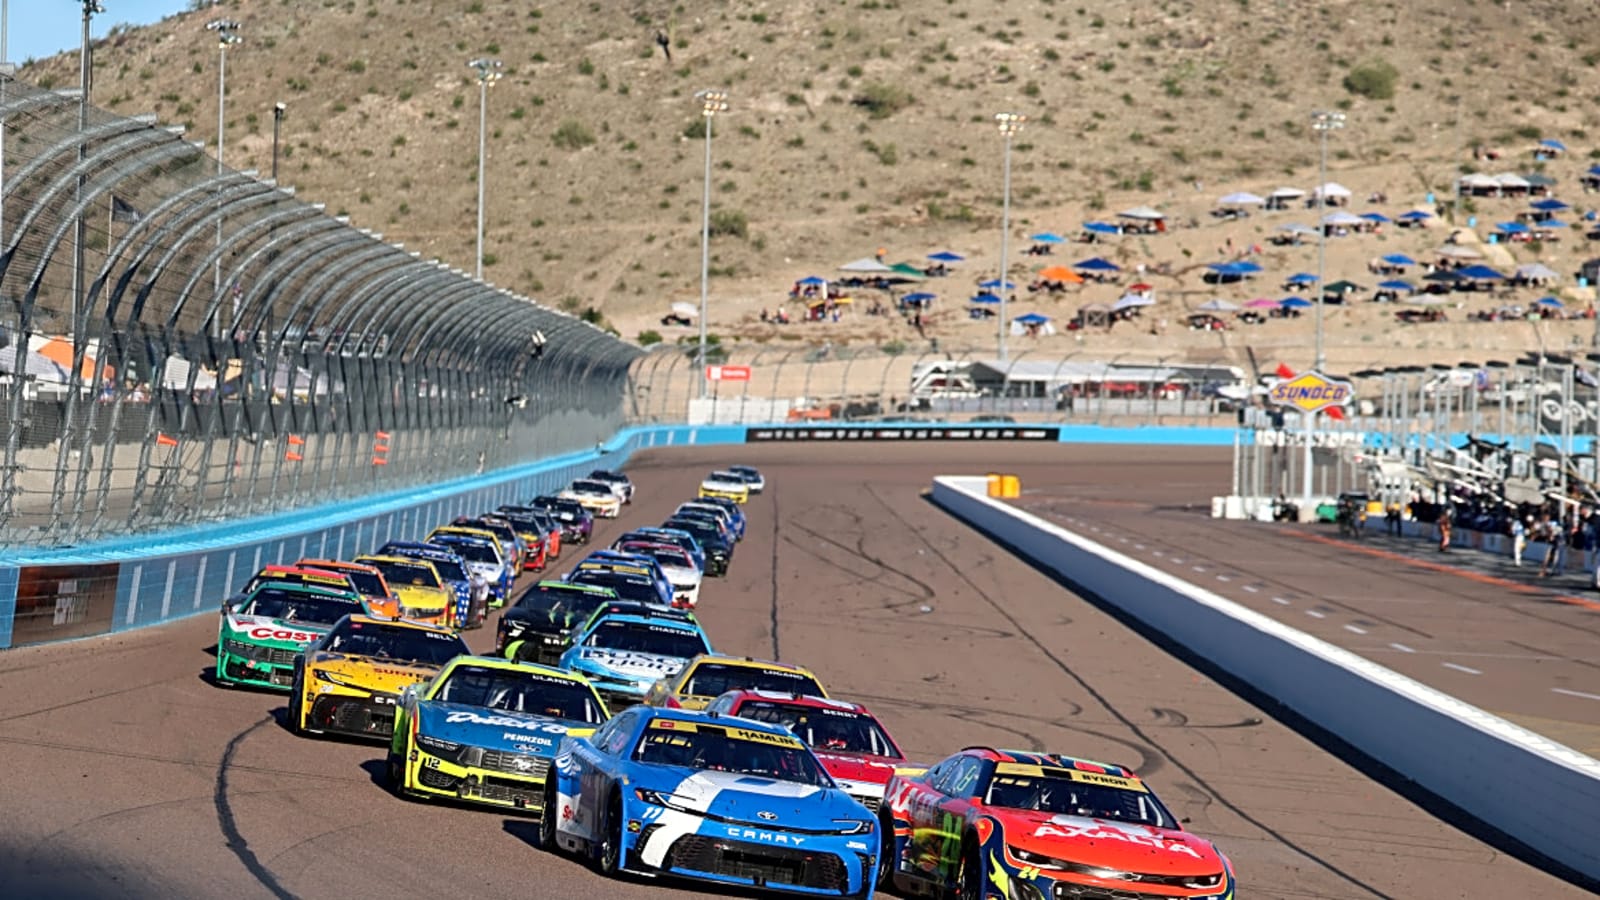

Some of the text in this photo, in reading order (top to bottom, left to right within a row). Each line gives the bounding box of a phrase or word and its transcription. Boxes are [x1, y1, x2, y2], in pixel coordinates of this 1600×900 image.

[1276, 386, 1345, 400] SUNOCO
[251, 628, 319, 641] Cast
[426, 632, 453, 641] BELL
[649, 625, 698, 637] CHASTAIN
[763, 669, 804, 680] LOGANO
[822, 708, 859, 719] BERRY
[503, 732, 553, 746] PENNZOIL
[737, 729, 796, 746] HAMLIN
[427, 757, 441, 770] 12
[1081, 774, 1129, 786] BYRON
[642, 807, 662, 819] 11
[727, 827, 805, 845] CAMRY
[1033, 826, 1202, 858] AXALTA
[1017, 866, 1040, 880] 24
